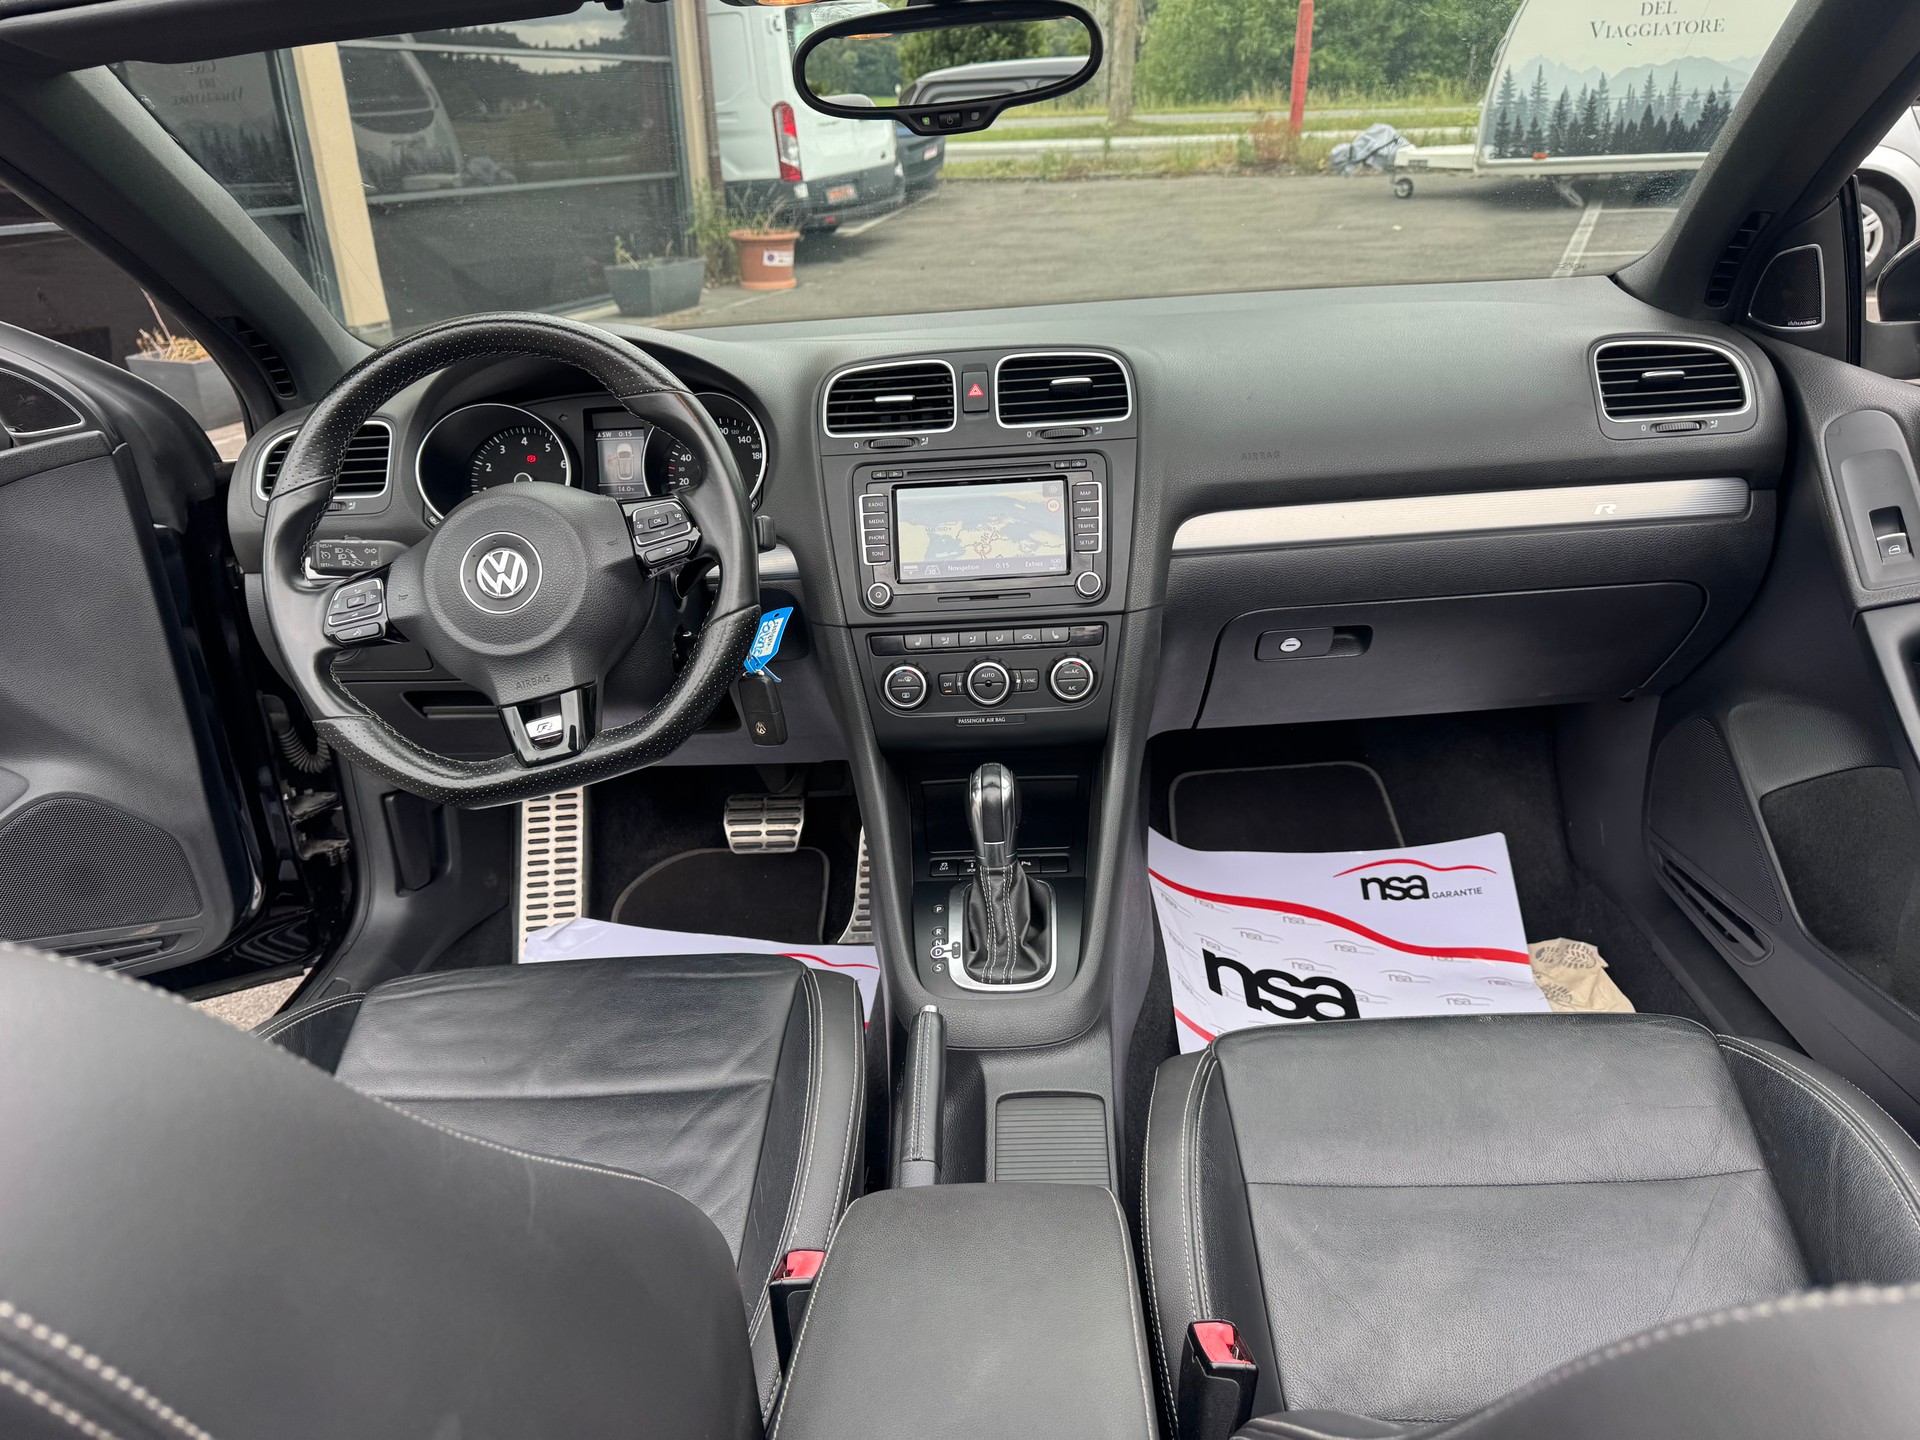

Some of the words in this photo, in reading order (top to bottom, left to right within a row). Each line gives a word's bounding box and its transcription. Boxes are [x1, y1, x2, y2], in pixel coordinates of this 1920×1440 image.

[1641, 1, 1677, 16] DEL
[1590, 18, 1725, 39] VIAGGIATORE
[521, 437, 528, 445] 4
[500, 445, 506, 454] 3
[545, 444, 551, 452] 5
[1241, 451, 1281, 460] AIRBAG
[485, 463, 492, 472] 2
[948, 564, 980, 573] Navigation
[515, 674, 551, 690] AIRBAG
[1360, 874, 1430, 901] nsa
[1432, 887, 1483, 899] GARANTIE
[1283, 915, 1306, 926] nsa
[1240, 930, 1263, 942] nsa
[1201, 937, 1221, 952] nsa
[1333, 944, 1358, 954] nsa
[1291, 960, 1315, 972] nsa
[1388, 973, 1413, 983] nsa
[1202, 948, 1361, 1022] nsa
[1446, 997, 1472, 1006] nsa
